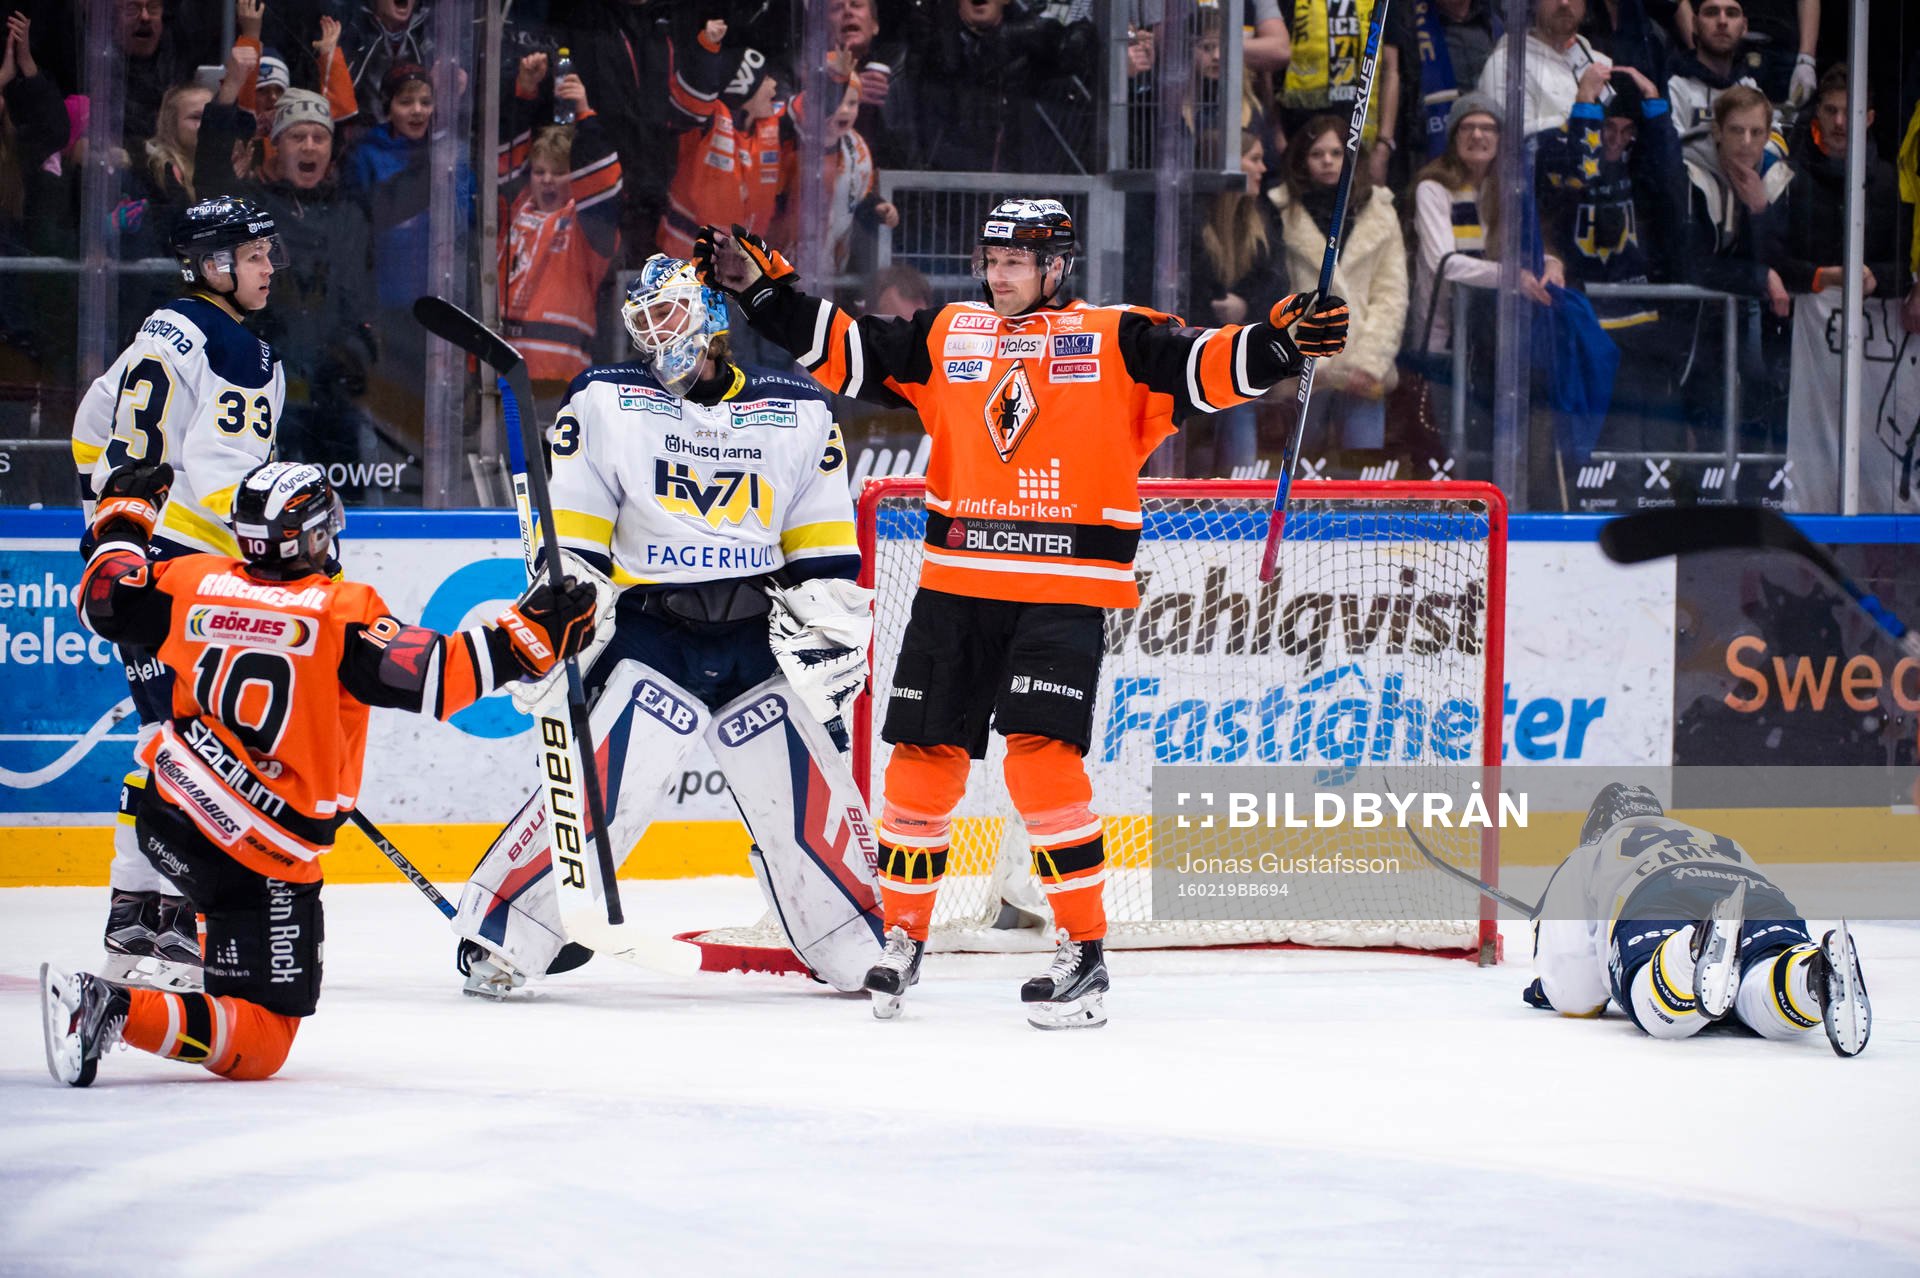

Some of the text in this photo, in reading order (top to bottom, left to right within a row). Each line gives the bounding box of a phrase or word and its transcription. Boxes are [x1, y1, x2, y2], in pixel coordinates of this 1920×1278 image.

[1347, 56, 1374, 151] NEXUS
[957, 316, 993, 329] SAVE
[142, 318, 194, 356] usqvarna
[1065, 335, 1093, 348] MCT
[585, 367, 653, 379] FAGERHUL
[947, 360, 983, 373] BAGA
[216, 388, 273, 441] 33
[634, 398, 680, 416] Liljedahl
[743, 400, 792, 411] INTERSPORT
[745, 412, 795, 424] Liljedahl
[681, 439, 762, 460] Husqvarna
[654, 457, 768, 520] HV71
[956, 498, 1073, 519] rintfabriken
[966, 520, 1017, 531] KARLSKRONA
[247, 538, 267, 555] 10
[966, 529, 1072, 555] BILCENTER
[209, 611, 287, 636] BÖRJES
[358, 616, 401, 650] 10
[0, 616, 123, 665] telec
[193, 643, 295, 757] 10
[892, 686, 923, 700] oxtec
[1032, 679, 1084, 700] Roxtec
[635, 681, 696, 733] EAB
[721, 697, 784, 745] EAB
[508, 804, 548, 863] BAU
[377, 839, 442, 902] NEXUS
[270, 924, 303, 983] Rock
